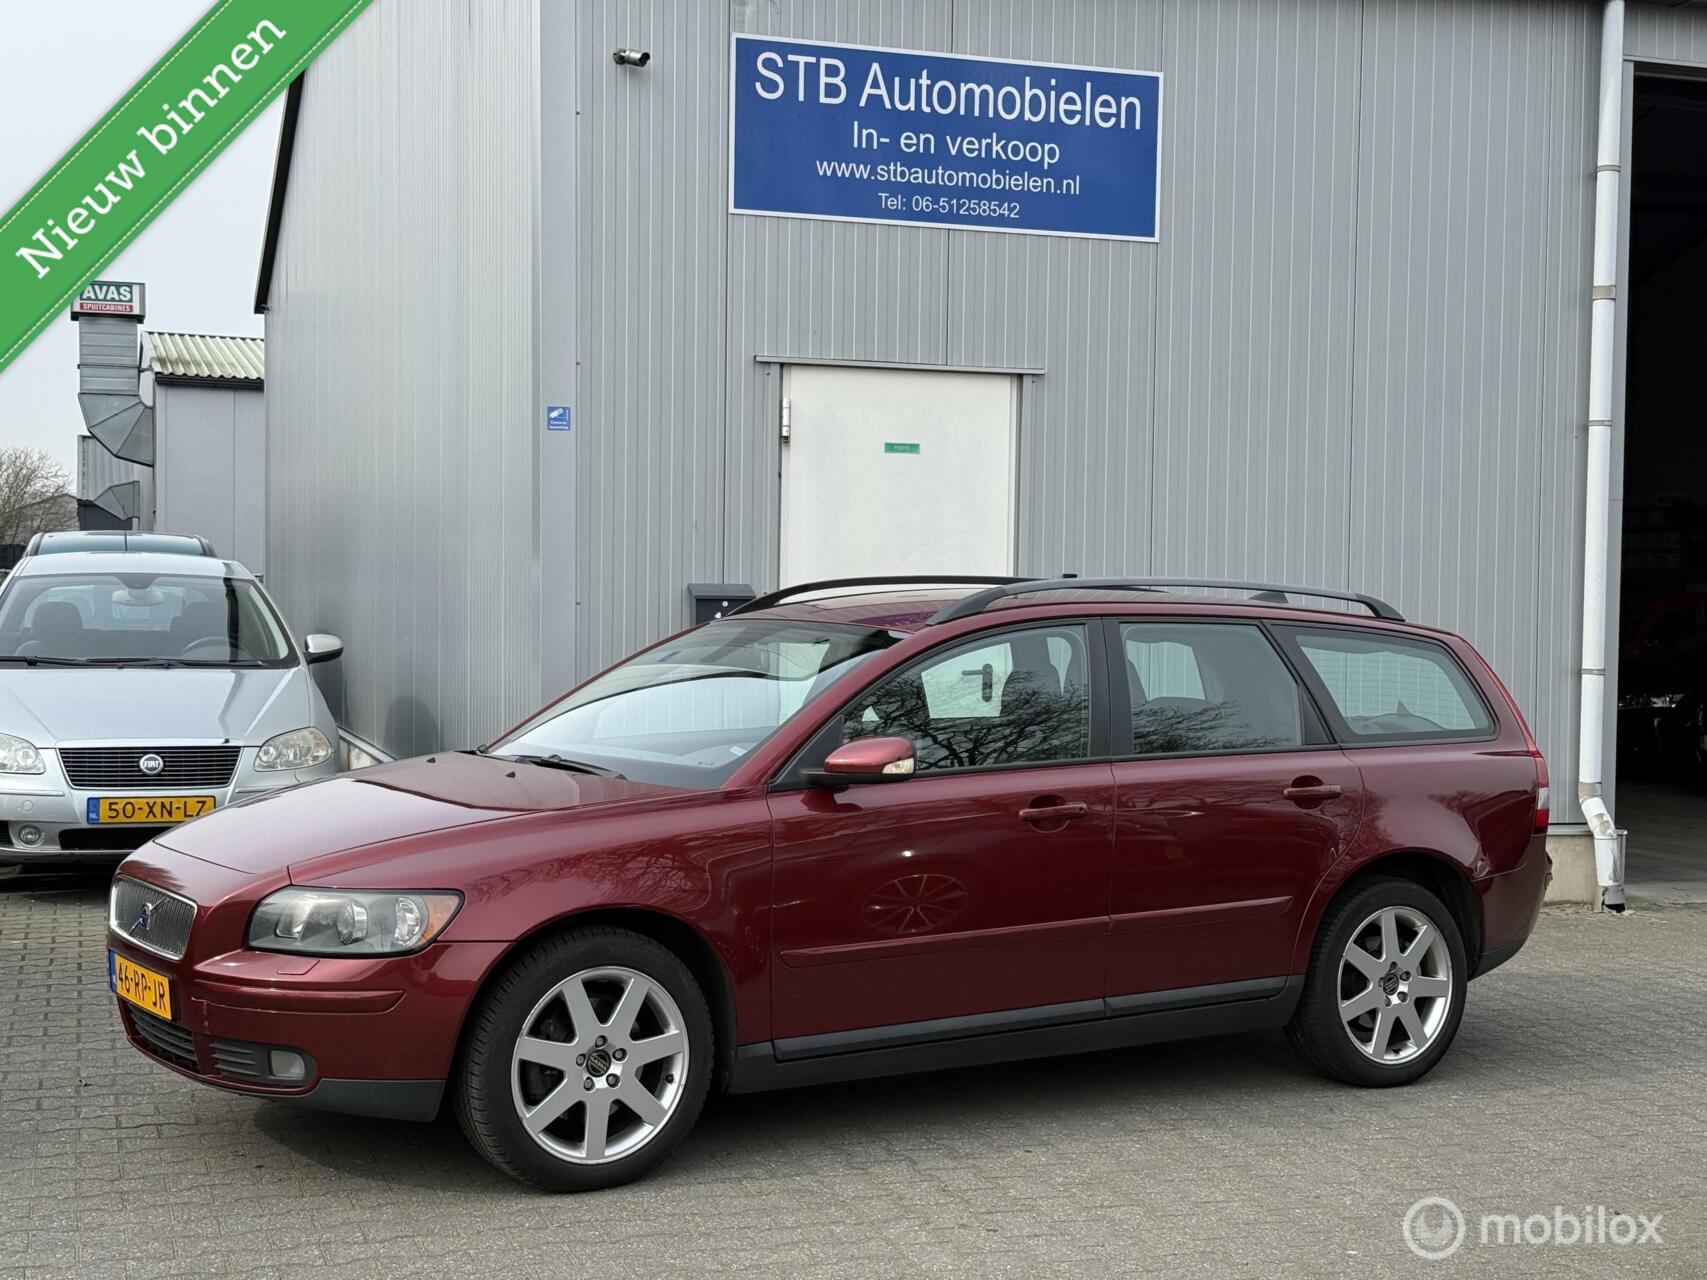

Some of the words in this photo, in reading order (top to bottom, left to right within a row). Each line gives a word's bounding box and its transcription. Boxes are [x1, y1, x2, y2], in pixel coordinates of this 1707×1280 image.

[754, 51, 848, 105] STB
[859, 62, 1142, 130] Automobielen
[852, 120, 890, 150] In-
[900, 130, 935, 154] en
[946, 132, 1060, 169] verkoop
[816, 159, 1080, 195] www.stbautomobielen.nl
[878, 193, 907, 211] Tel:
[912, 195, 1020, 219] 06-51258542
[82, 284, 131, 301] AVAS
[143, 760, 160, 768] FIAT
[118, 962, 167, 1012] 46-RP-JR
